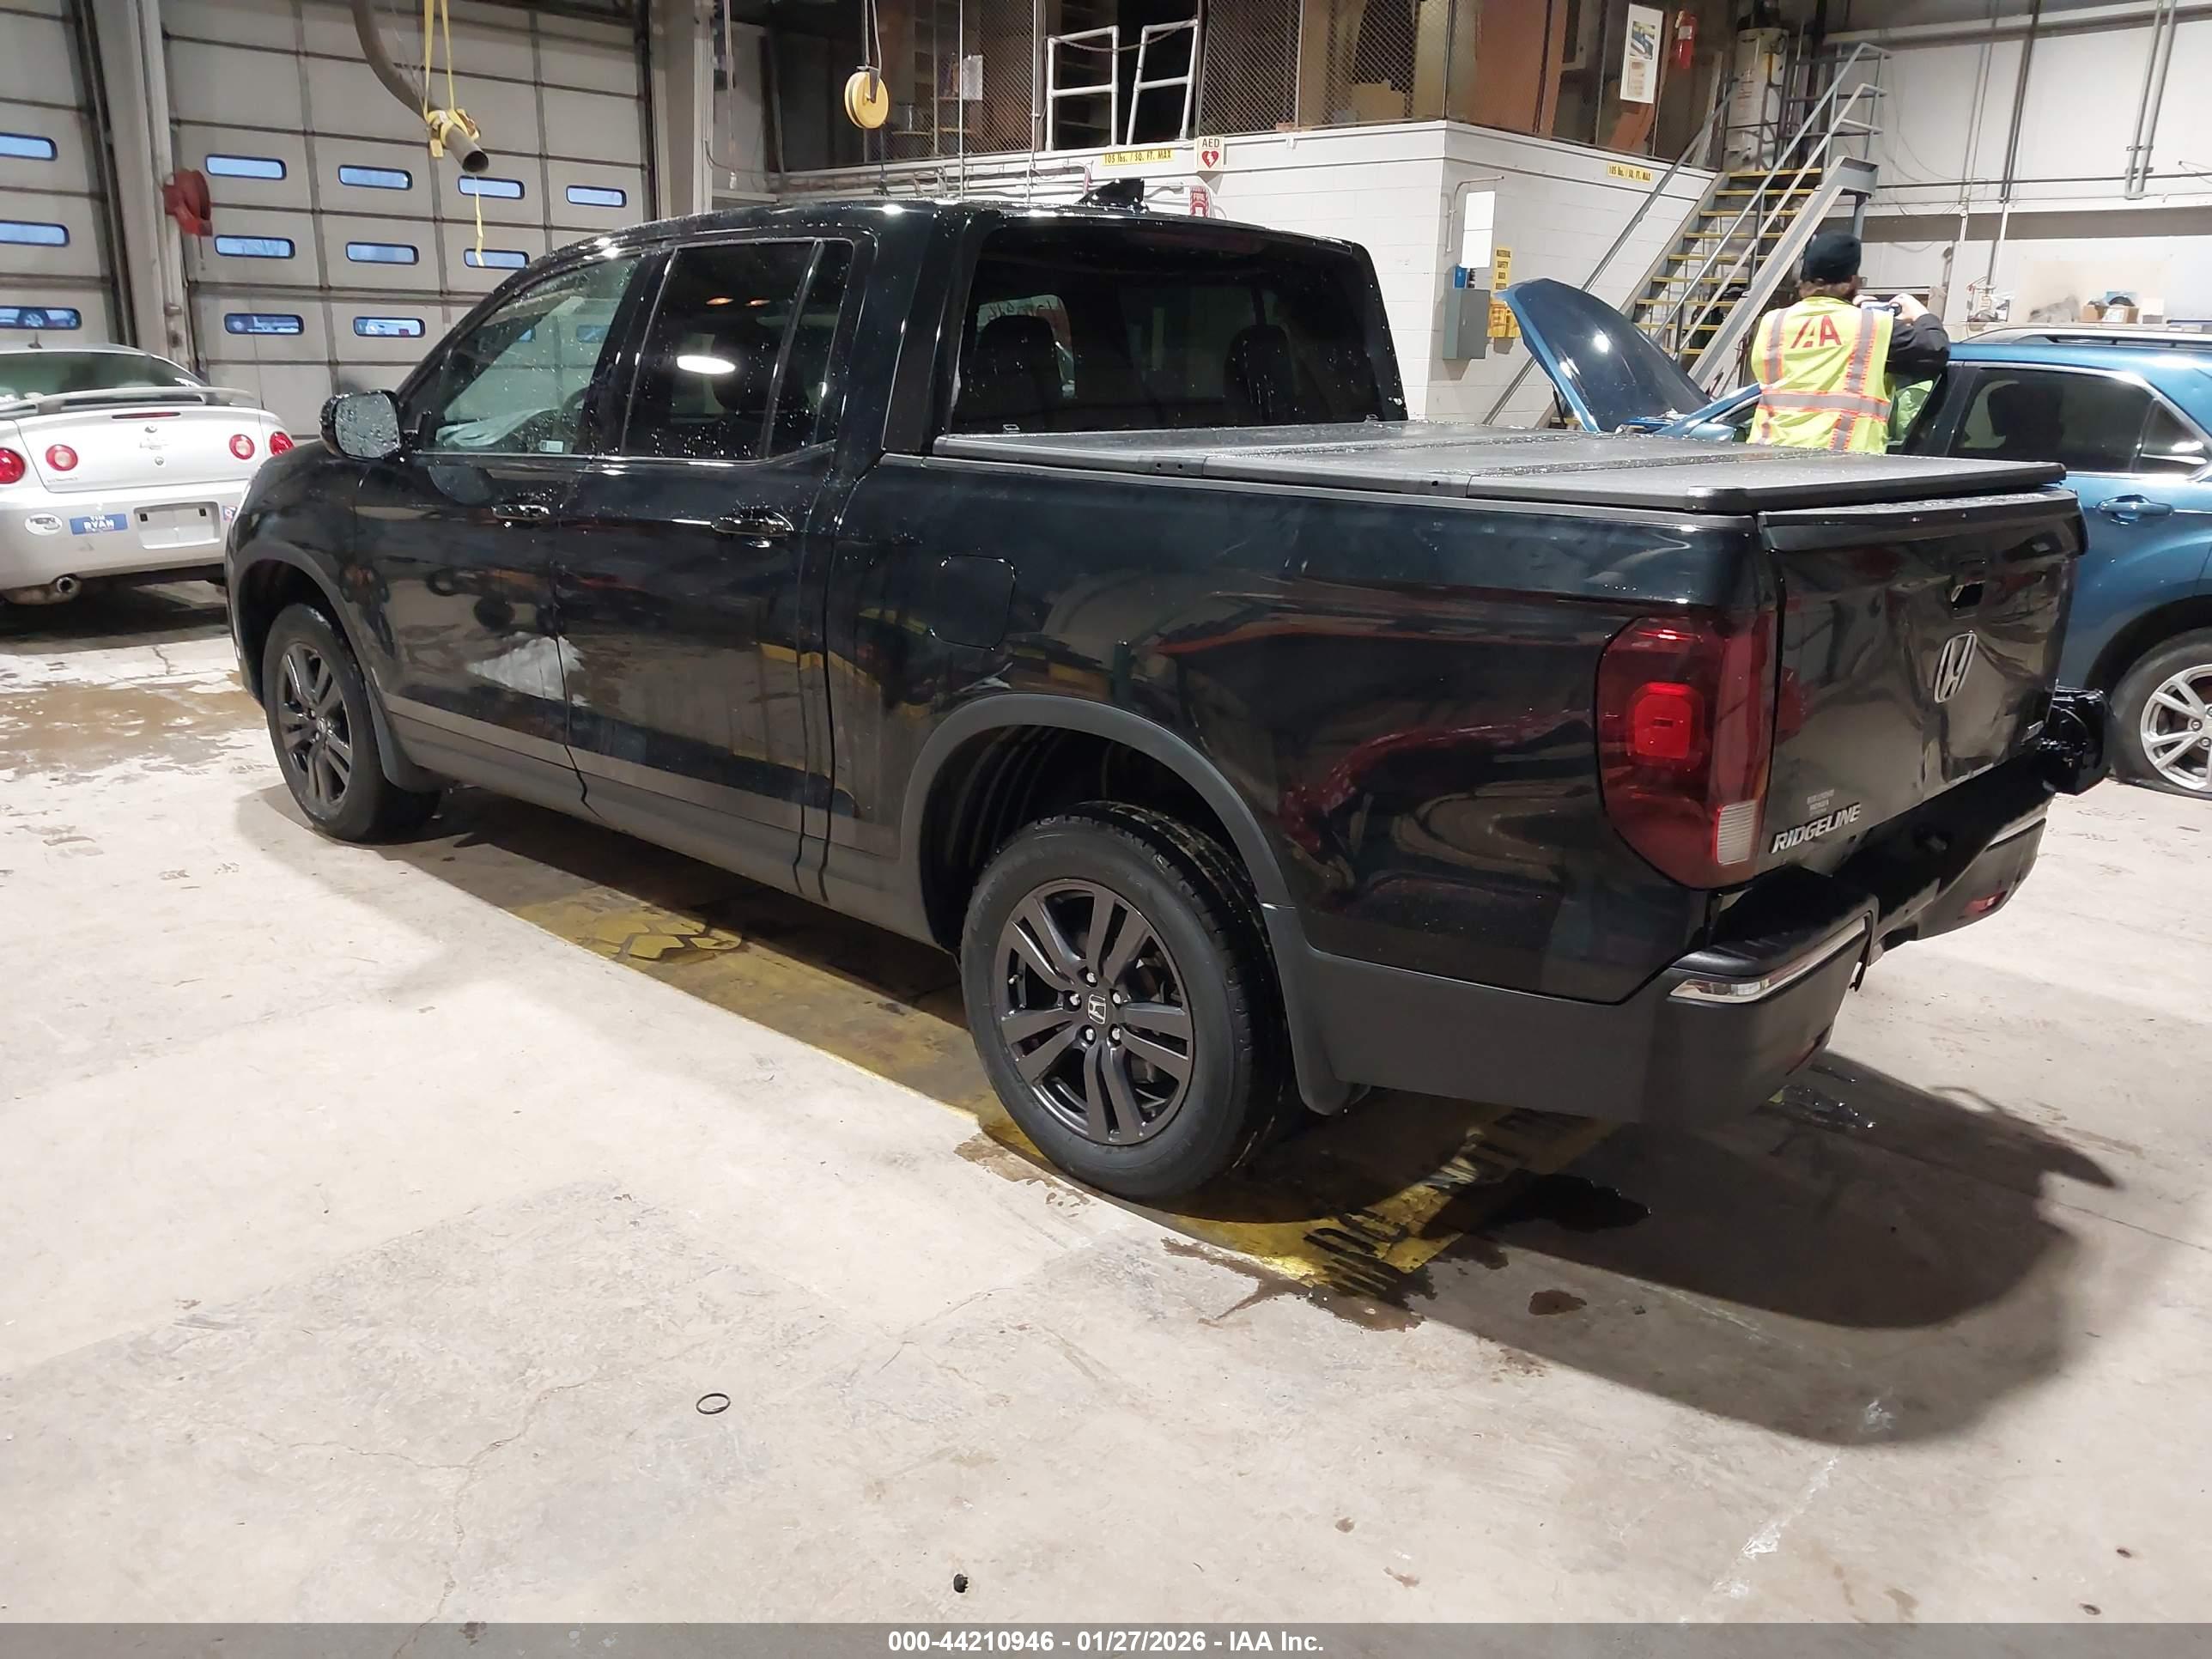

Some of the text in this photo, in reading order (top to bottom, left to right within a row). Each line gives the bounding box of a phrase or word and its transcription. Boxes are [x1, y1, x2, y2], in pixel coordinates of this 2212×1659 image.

[1202, 138, 1220, 148] AED
[1104, 154, 1115, 164] 105
[1117, 153, 1128, 162] lbs.
[1146, 151, 1155, 161] FT.
[1158, 149, 1171, 159] MAX
[83, 520, 115, 531] RYAN
[1771, 803, 1862, 854] RIDGELINE
